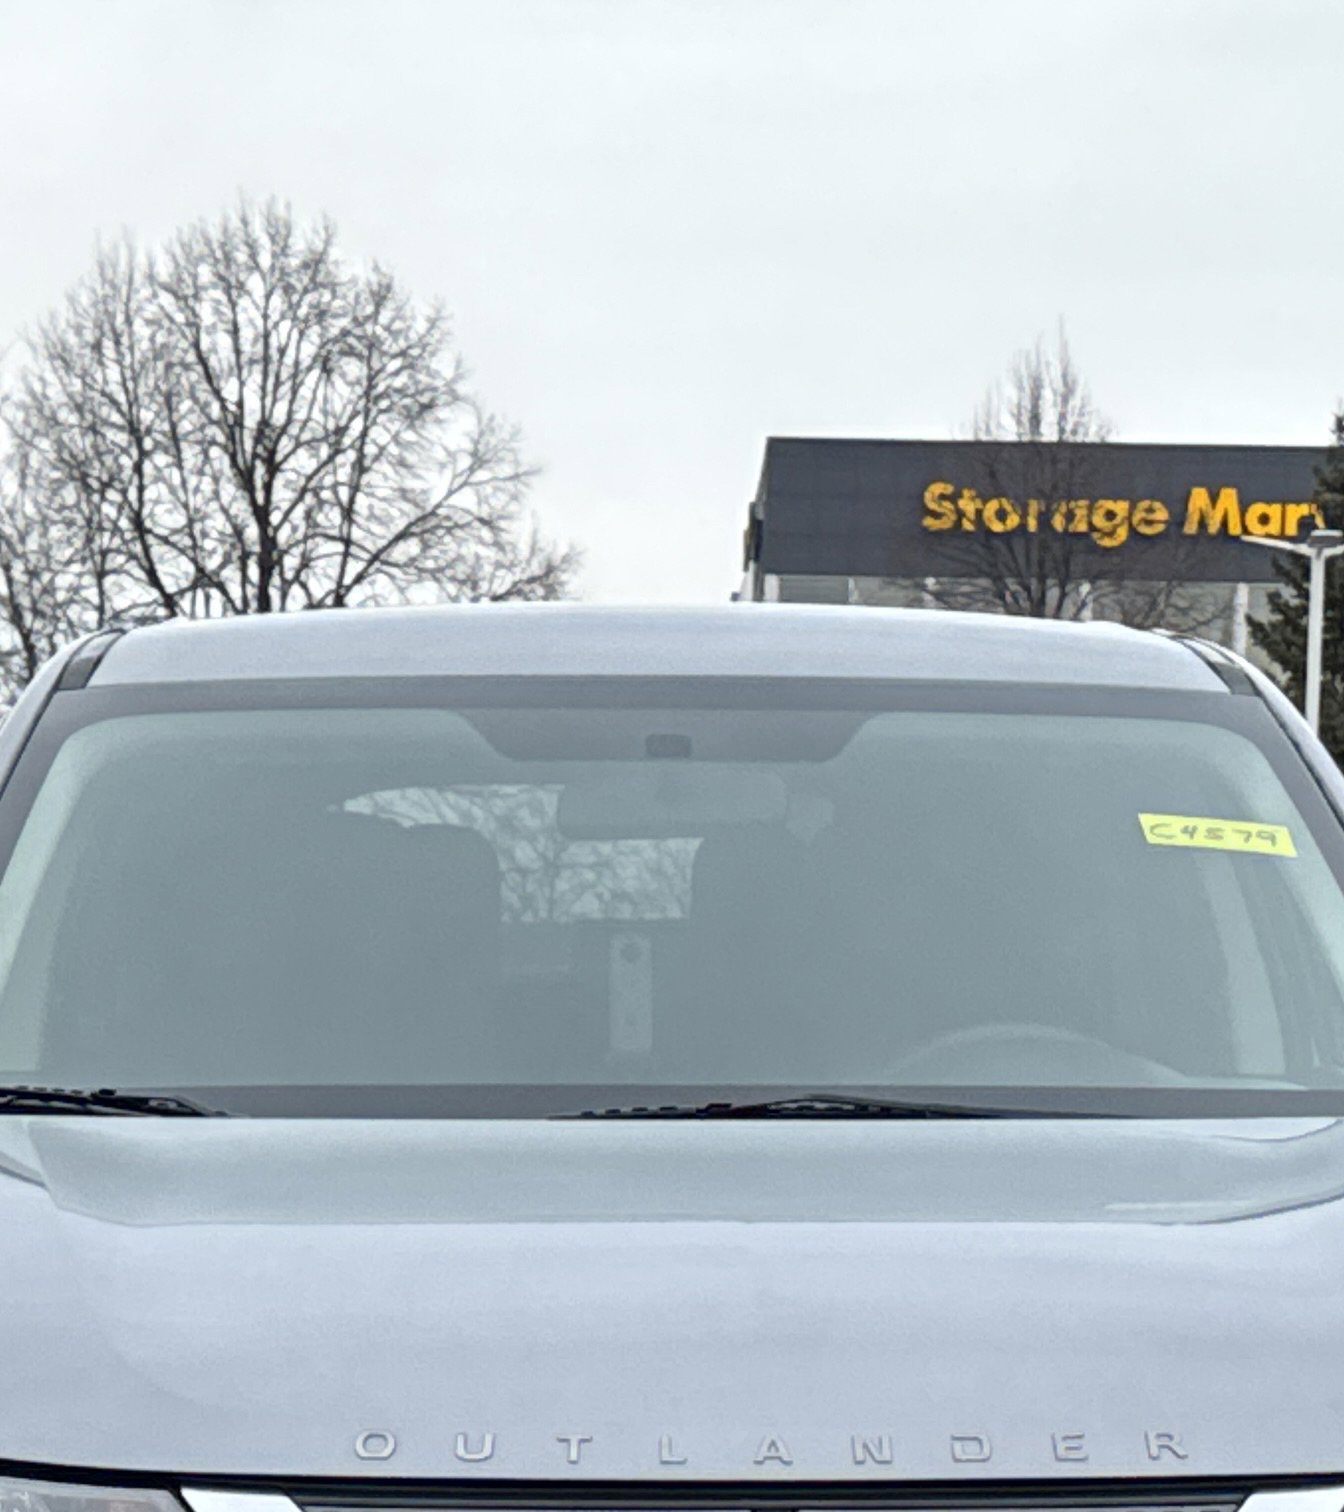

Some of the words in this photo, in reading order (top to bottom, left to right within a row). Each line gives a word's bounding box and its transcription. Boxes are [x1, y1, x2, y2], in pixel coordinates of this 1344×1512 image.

[921, 480, 1171, 548] Storage
[1182, 486, 1326, 537] Mar
[352, 1428, 1190, 1465] OUTLANDER
